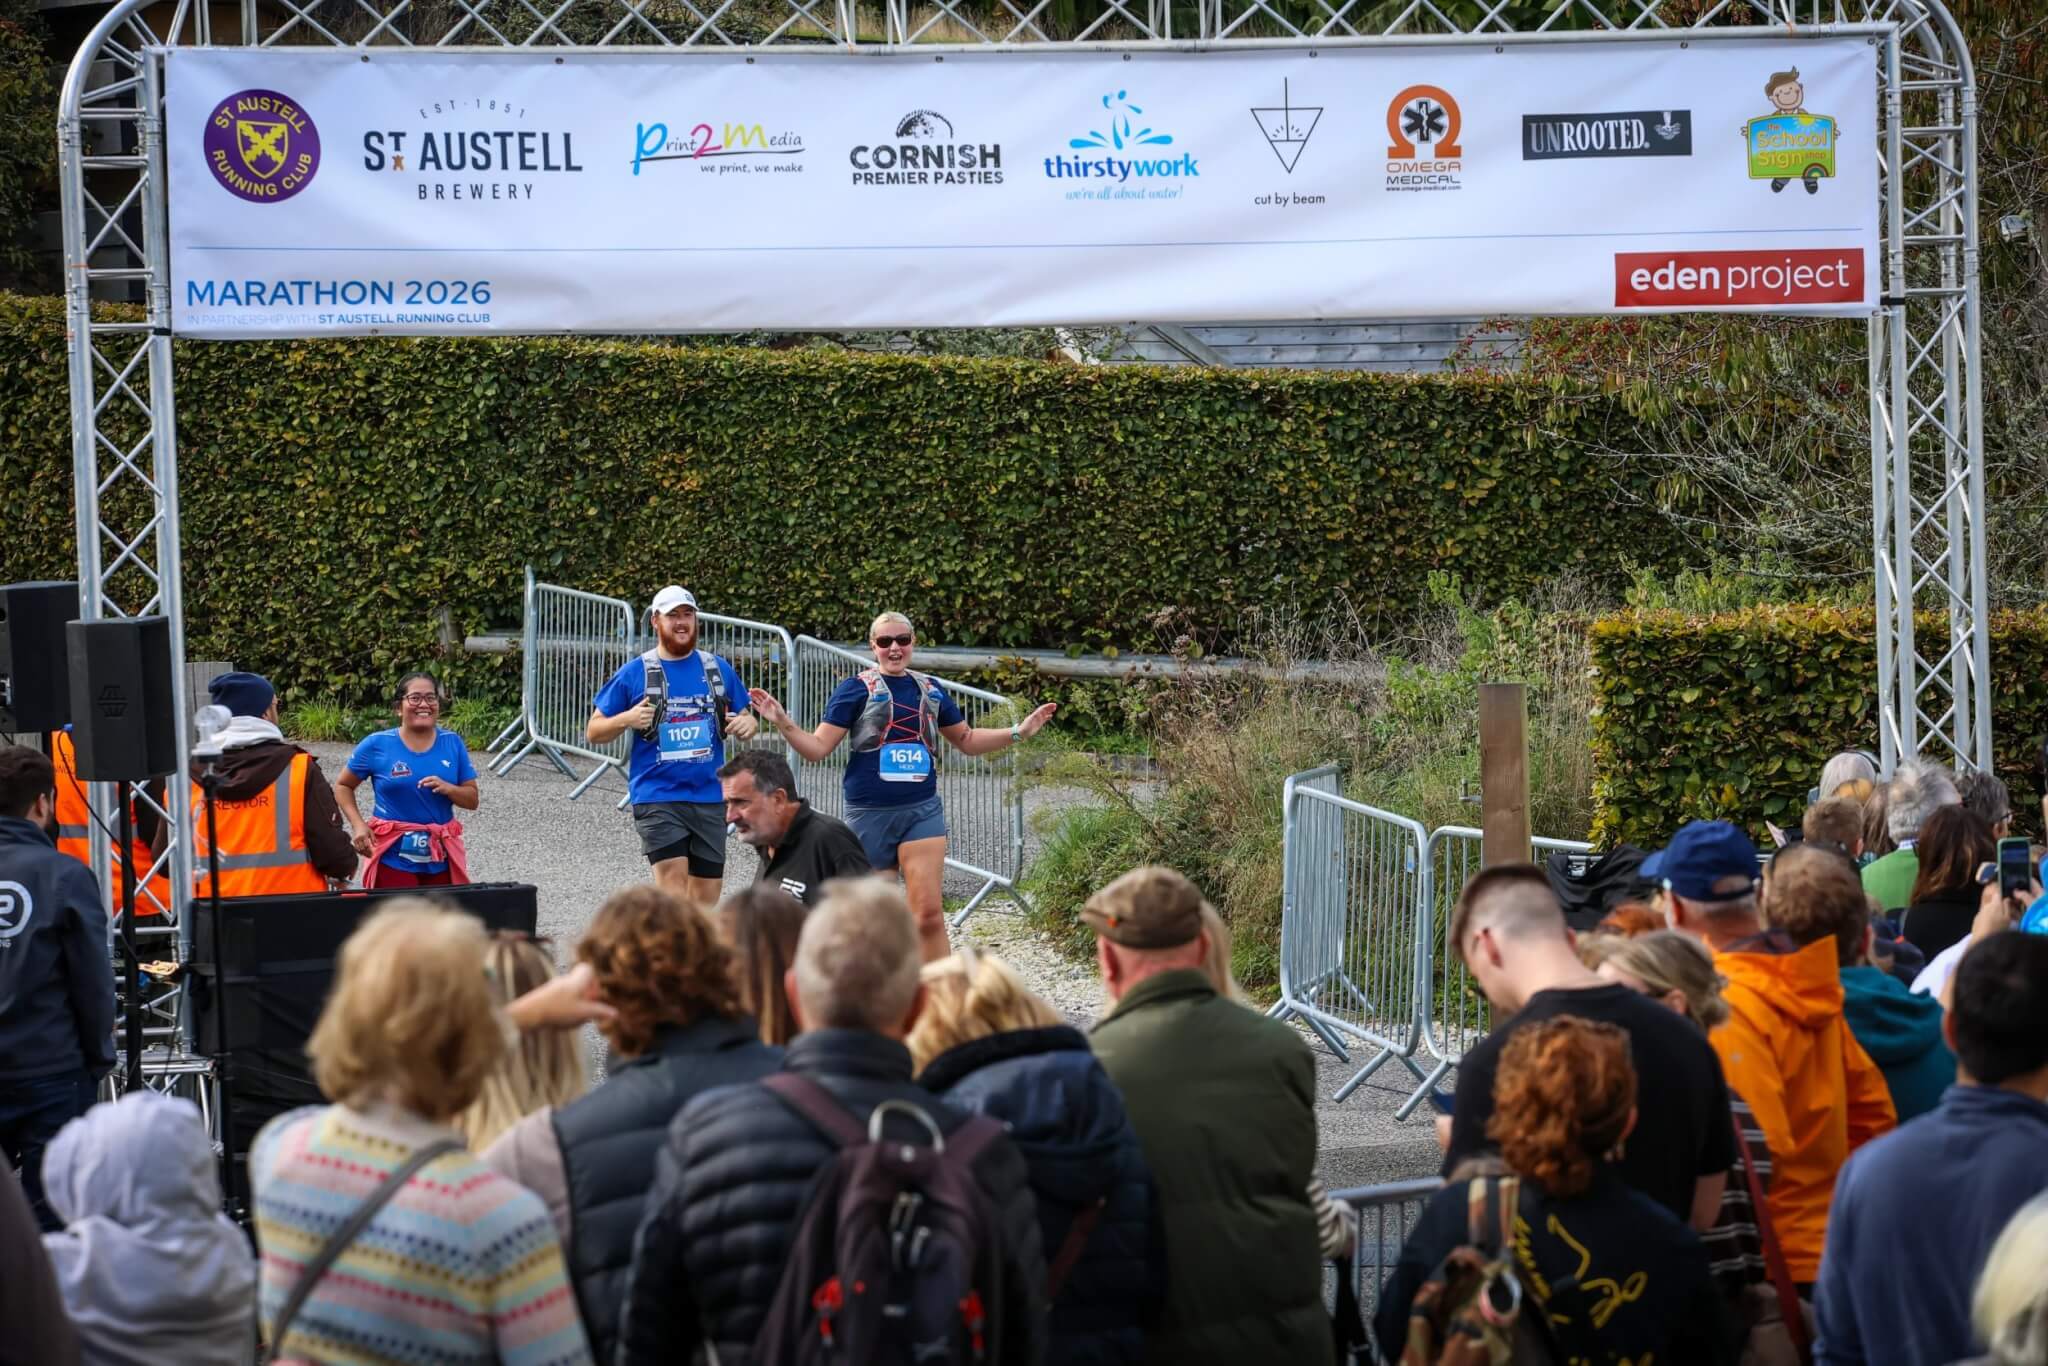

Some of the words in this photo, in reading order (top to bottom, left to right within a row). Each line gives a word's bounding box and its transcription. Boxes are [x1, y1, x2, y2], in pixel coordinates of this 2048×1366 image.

[215, 106, 234, 128] ST
[237, 97, 306, 134] AUSTELL
[1757, 128, 1827, 147] School
[419, 131, 583, 172] AUSTELL
[850, 144, 1001, 170] CORNISH
[1757, 150, 1803, 170] Sign
[213, 149, 278, 196] RUNNING
[282, 153, 312, 190] CLUB
[700, 164, 715, 173] we
[754, 163, 769, 173] we
[774, 162, 803, 173] make
[1044, 152, 1200, 183] thirstywork
[1386, 161, 1462, 173] OMEGA
[852, 172, 929, 185] PREMIER
[934, 171, 1004, 184] PASTIES
[1386, 175, 1461, 185] MEDICAL
[418, 183, 533, 200] BREWERY
[1096, 185, 1113, 200] all
[1114, 185, 1146, 200] about
[1254, 193, 1271, 205] cut
[1275, 192, 1289, 207] by
[1293, 192, 1326, 205] beam
[1630, 260, 1720, 291] eden
[1728, 258, 1850, 298] project
[187, 280, 395, 306] MARATHON
[405, 280, 491, 305] 2026
[202, 314, 284, 325] PARTNERSHIP
[286, 314, 317, 324] WITH
[318, 314, 335, 324] ST
[336, 313, 394, 324] AUSTELL
[397, 313, 455, 323] RUNNING
[457, 312, 491, 323] CLUB
[667, 726, 700, 742] 1107
[889, 749, 923, 763] 1614
